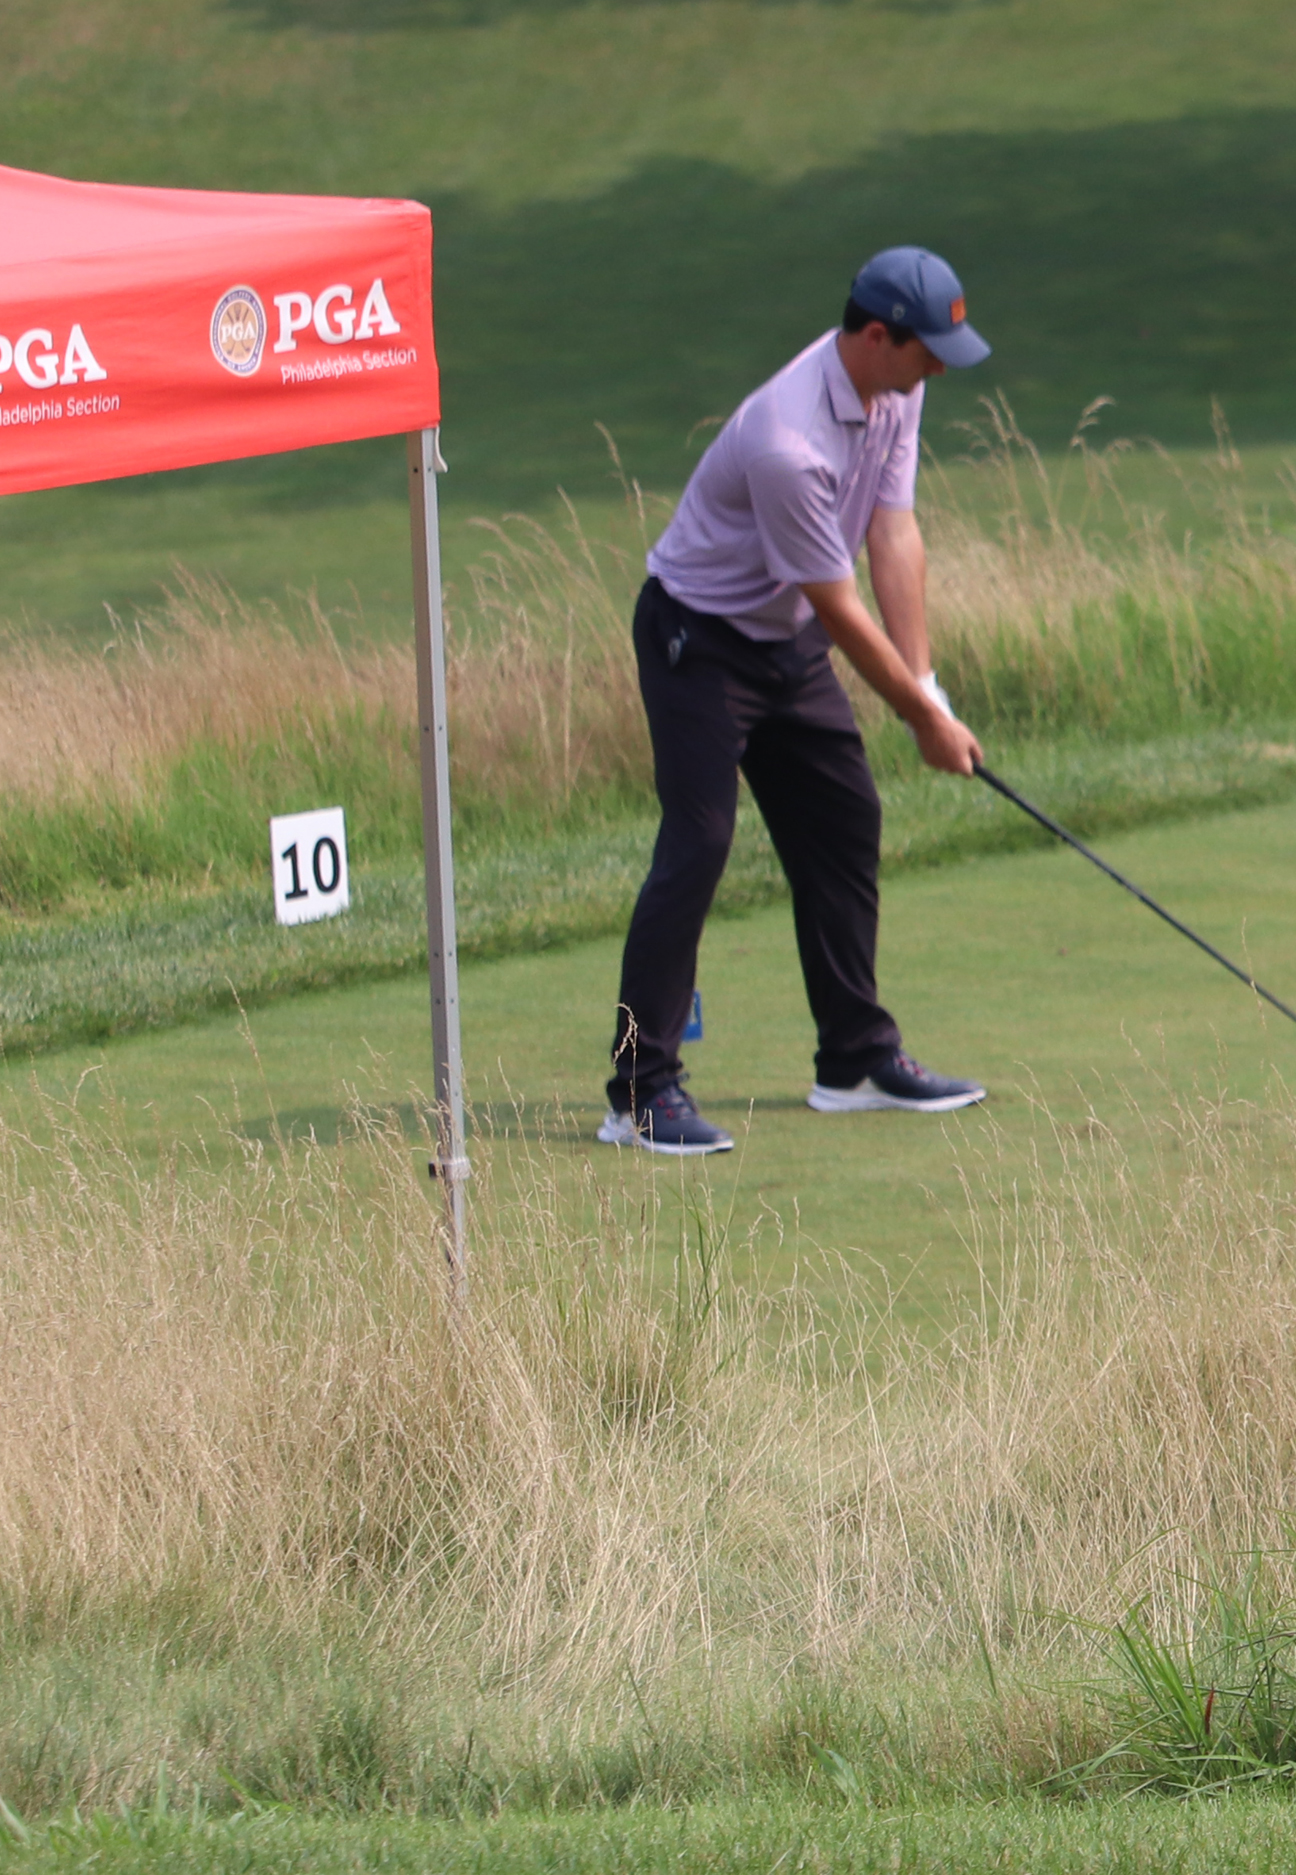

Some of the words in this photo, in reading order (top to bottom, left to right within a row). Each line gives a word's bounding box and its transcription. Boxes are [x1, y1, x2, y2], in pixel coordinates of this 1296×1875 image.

[221, 320, 257, 345] PGA
[273, 278, 401, 353] PGA
[280, 353, 363, 385] Philadelphia
[362, 347, 417, 371] Section
[66, 392, 121, 417] Section
[281, 836, 341, 901] 10
